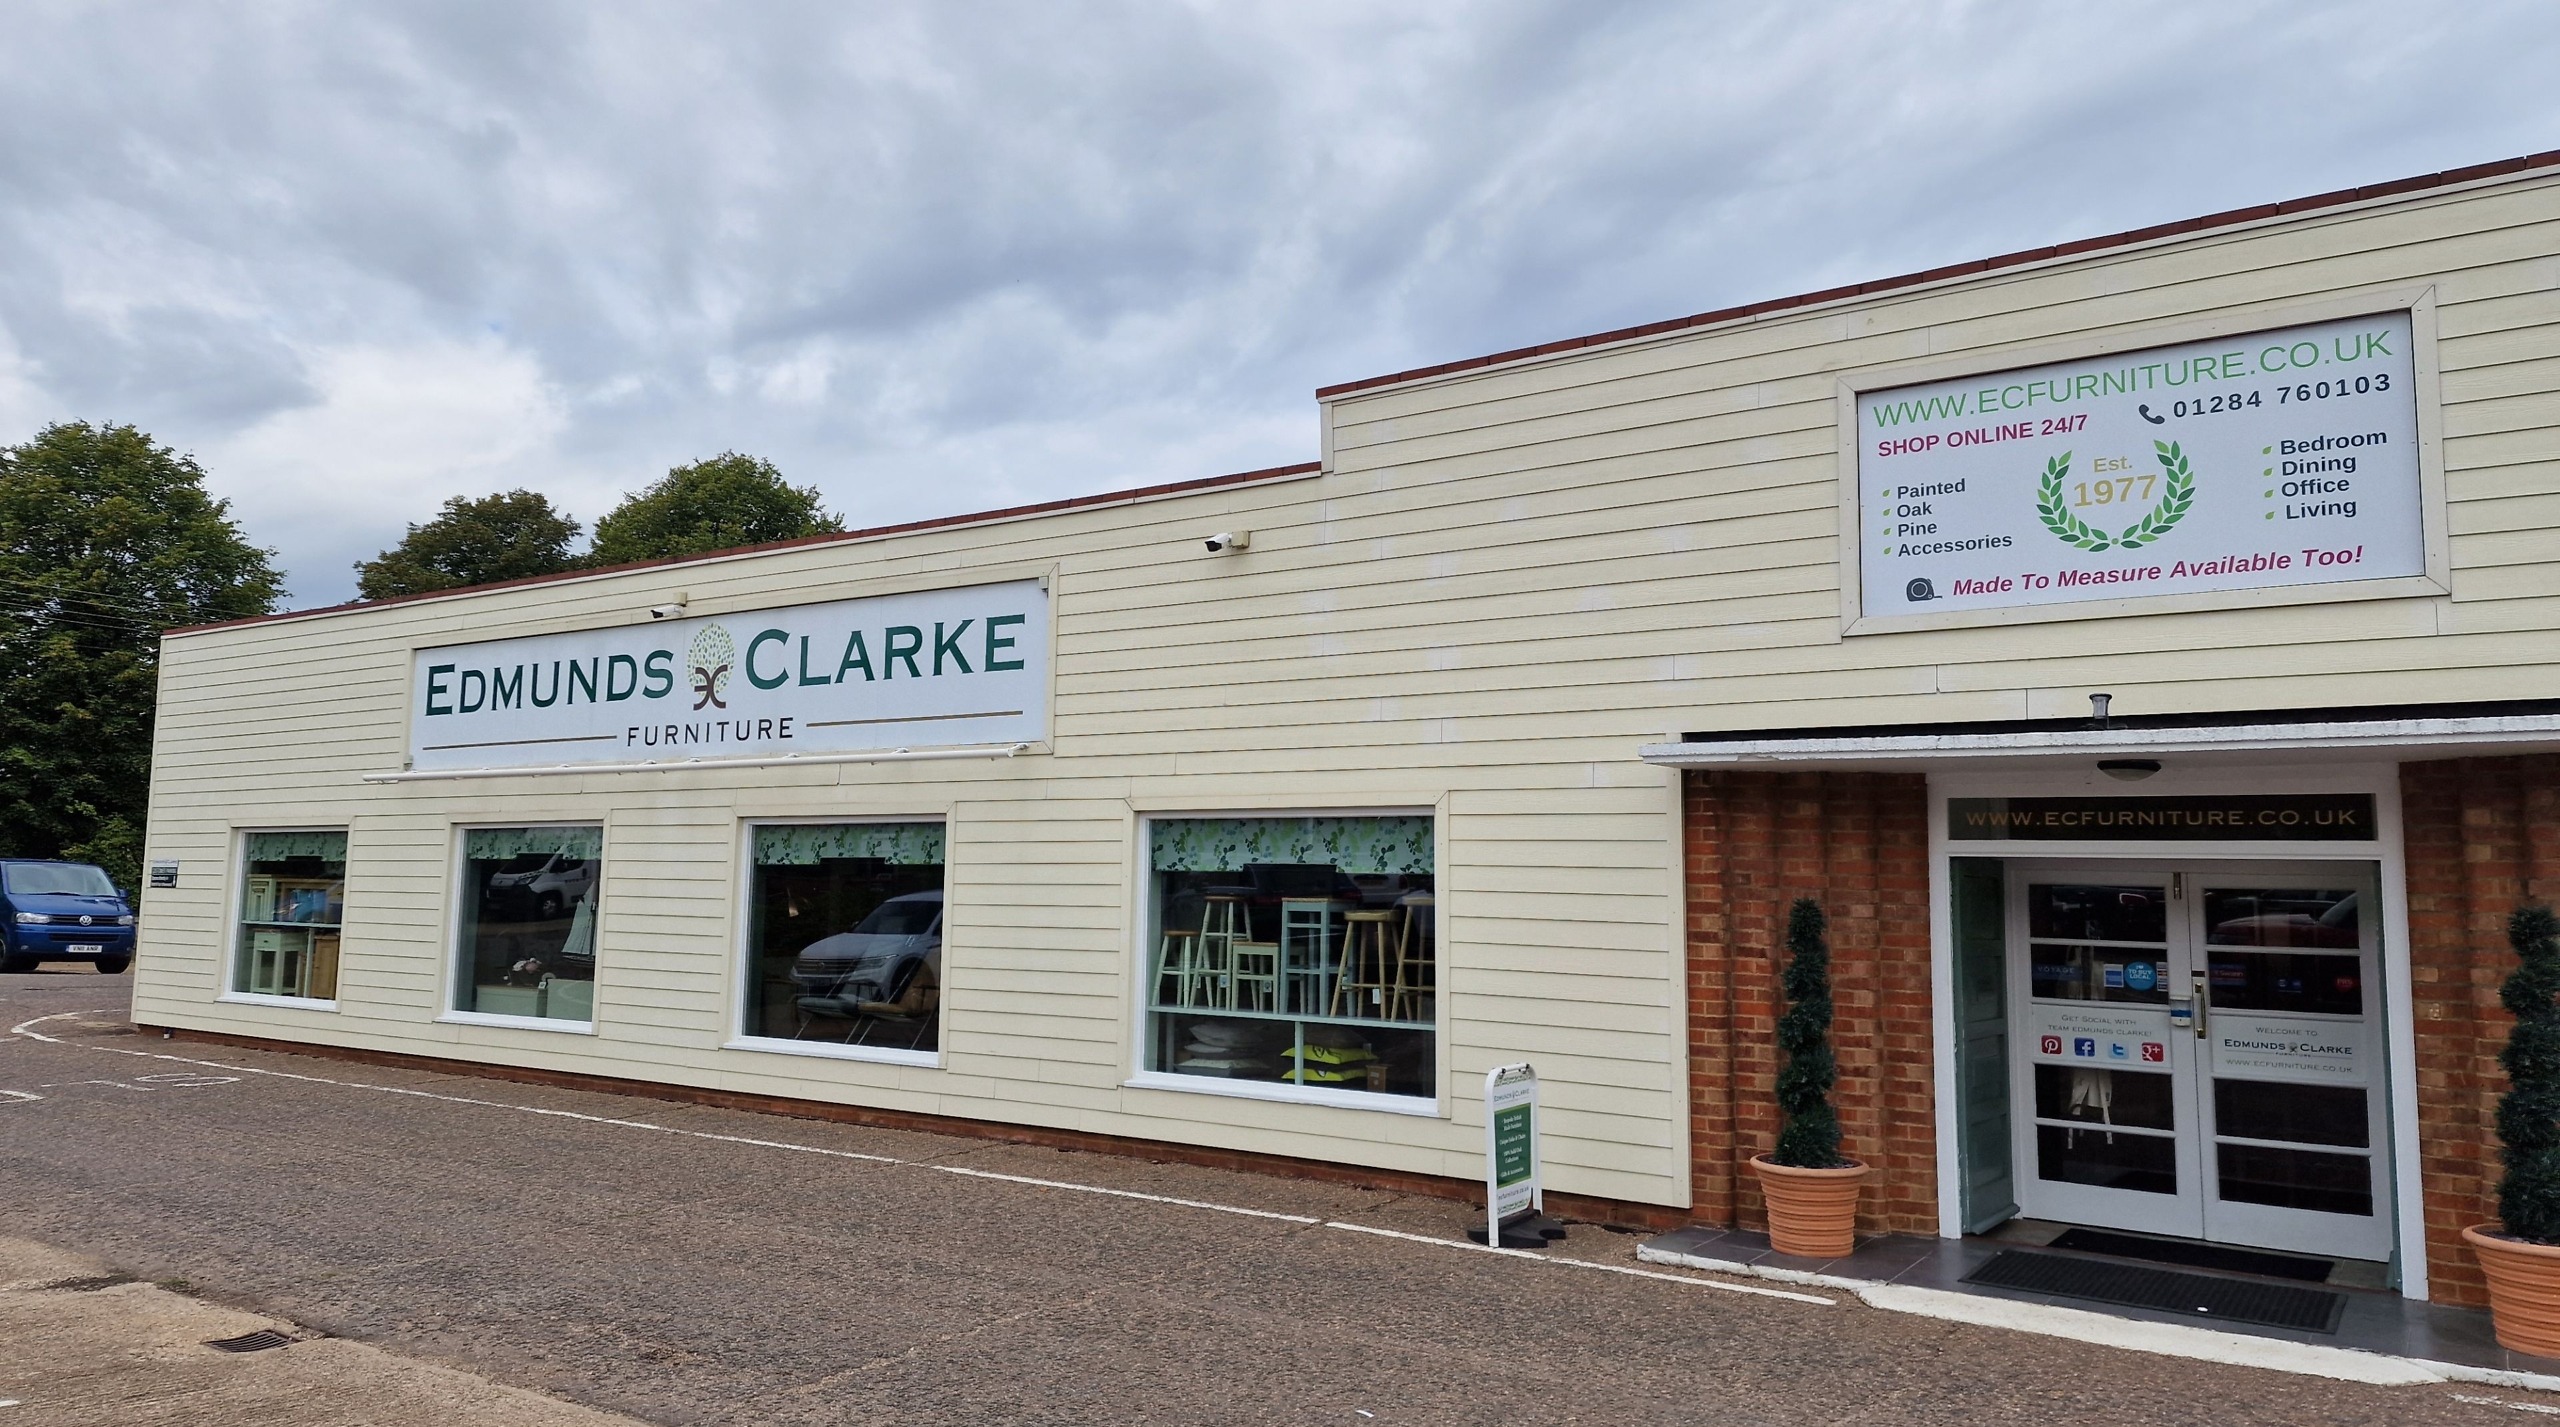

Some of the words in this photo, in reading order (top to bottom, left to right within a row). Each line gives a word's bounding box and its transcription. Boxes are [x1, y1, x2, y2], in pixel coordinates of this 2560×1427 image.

[1873, 330, 2394, 428] WWW.ECFURNITURE.CO.UK
[2173, 390, 2263, 418] 01284
[2277, 373, 2391, 404] 760103
[1878, 434, 1940, 457] SHOP
[1946, 421, 2034, 449] ONLINE
[2041, 414, 2088, 436] 24/7
[2280, 429, 2388, 456] Bedroom
[2093, 455, 2133, 473] Est.
[2281, 454, 2357, 479] Dining
[1897, 478, 1966, 499] Painted
[2073, 474, 2158, 507] 1977
[2281, 476, 2350, 498] Office
[1896, 501, 1933, 518] Oak
[2285, 499, 2357, 523] Living
[1897, 519, 1938, 537] Pine
[1897, 533, 2013, 557] Accessories
[1953, 575, 2013, 596] Made
[2021, 572, 2049, 591] To
[2057, 563, 2163, 588] Measure
[2169, 551, 2291, 578] Available
[2302, 545, 2363, 568] Too!
[425, 650, 674, 716] EDMUNDS
[746, 614, 1026, 690] CLARKE
[627, 717, 794, 746] FURNITURE
[1966, 810, 2357, 826] WWW.ECFURNITURE.CO.UK
[2072, 1026, 2113, 1035] EDMUNDS
[2082, 1016, 2111, 1024] SOCIAL
[2256, 1027, 2301, 1036] WELCOME
[2224, 1039, 2286, 1050] EDMUNDS
[2300, 1043, 2352, 1054] CLARKE
[2226, 1058, 2352, 1072] WWW.ECFURNITURE.CO.UK
